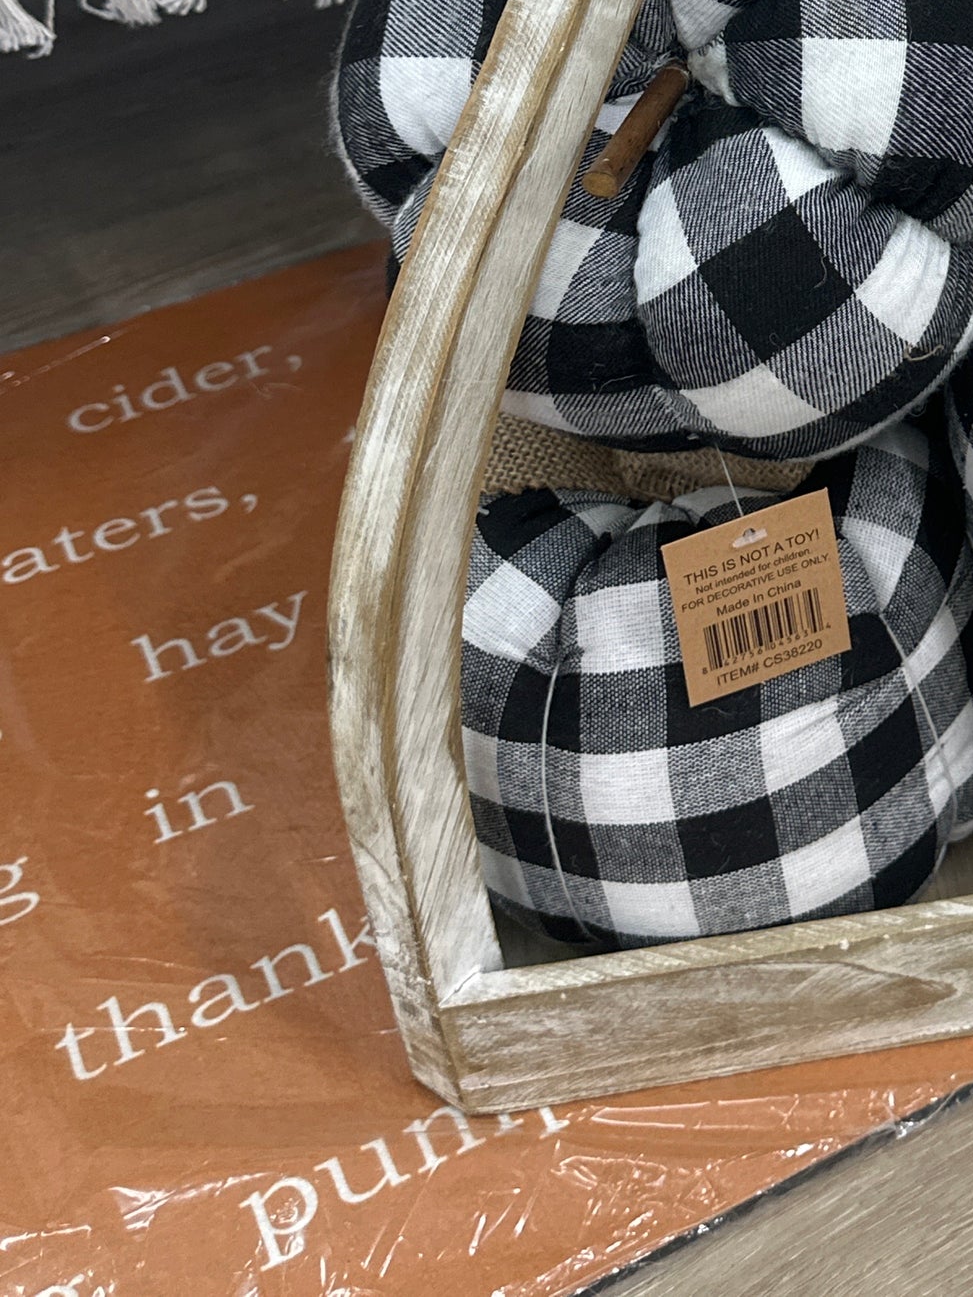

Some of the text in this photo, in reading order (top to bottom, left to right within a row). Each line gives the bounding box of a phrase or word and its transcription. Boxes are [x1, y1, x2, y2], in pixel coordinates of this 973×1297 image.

[65, 343, 304, 434] cider,
[683, 528, 820, 585] THIS IS NOT A TOY!
[695, 582, 713, 595] Not
[715, 566, 756, 589] intended
[758, 562, 773, 573] for
[681, 597, 705, 613] FOR
[706, 572, 775, 603] DECORATIVE
[777, 563, 799, 577] USE
[716, 598, 750, 617] Made
[767, 579, 802, 598] China
[131, 590, 308, 683] hay
[716, 638, 823, 686] ITEM# CS38220
[143, 777, 255, 845] in
